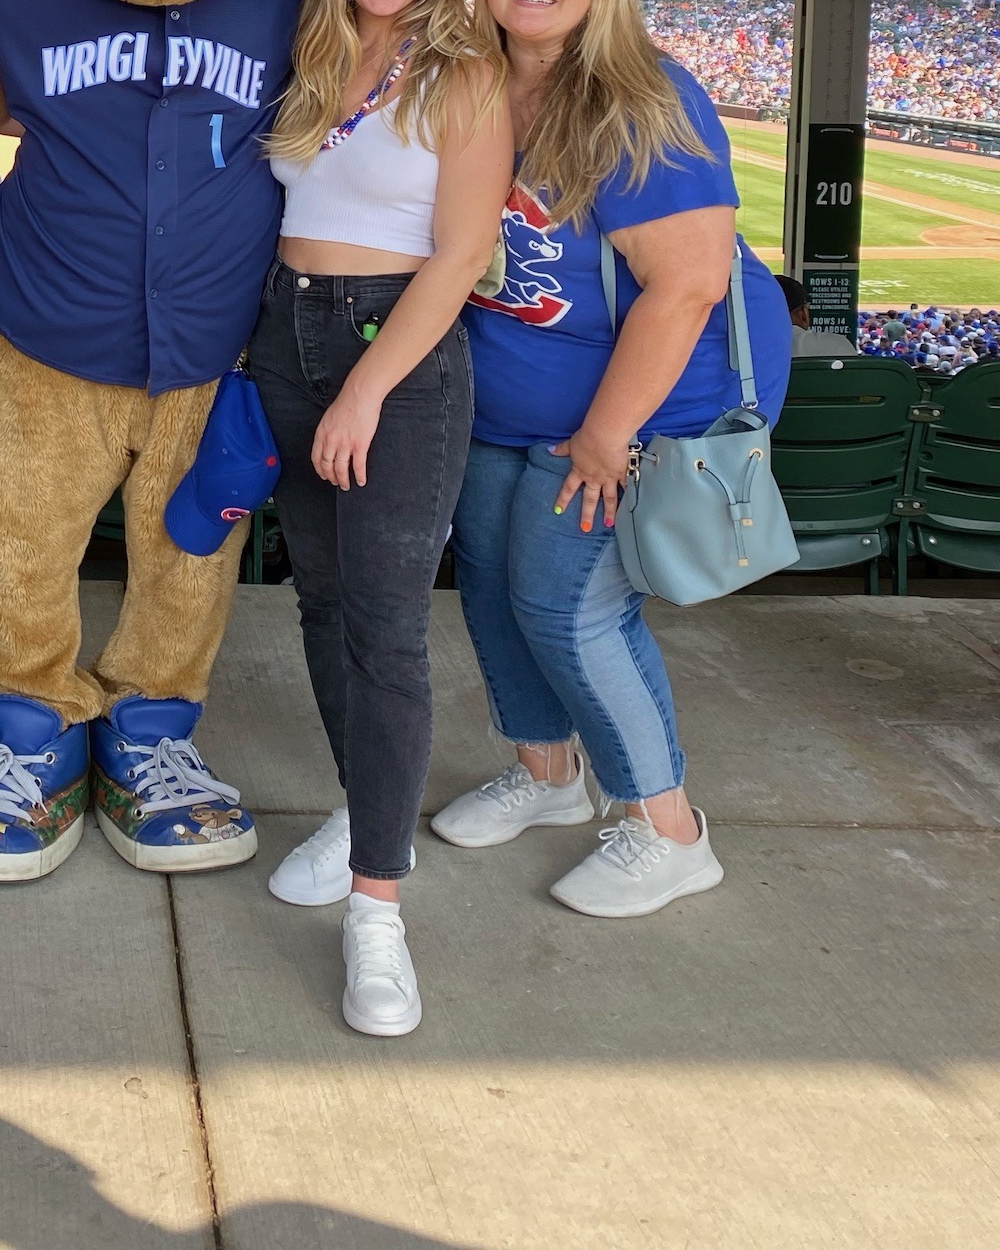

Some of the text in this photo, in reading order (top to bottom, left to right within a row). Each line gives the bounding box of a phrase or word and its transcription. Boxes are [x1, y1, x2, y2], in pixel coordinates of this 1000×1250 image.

[208, 114, 226, 169] 1
[816, 181, 852, 206] 210
[810, 278, 832, 286] ROWS
[834, 278, 851, 286] 1-13:
[813, 317, 846, 325] ROWS 14
[824, 326, 852, 334] ABOVE:
